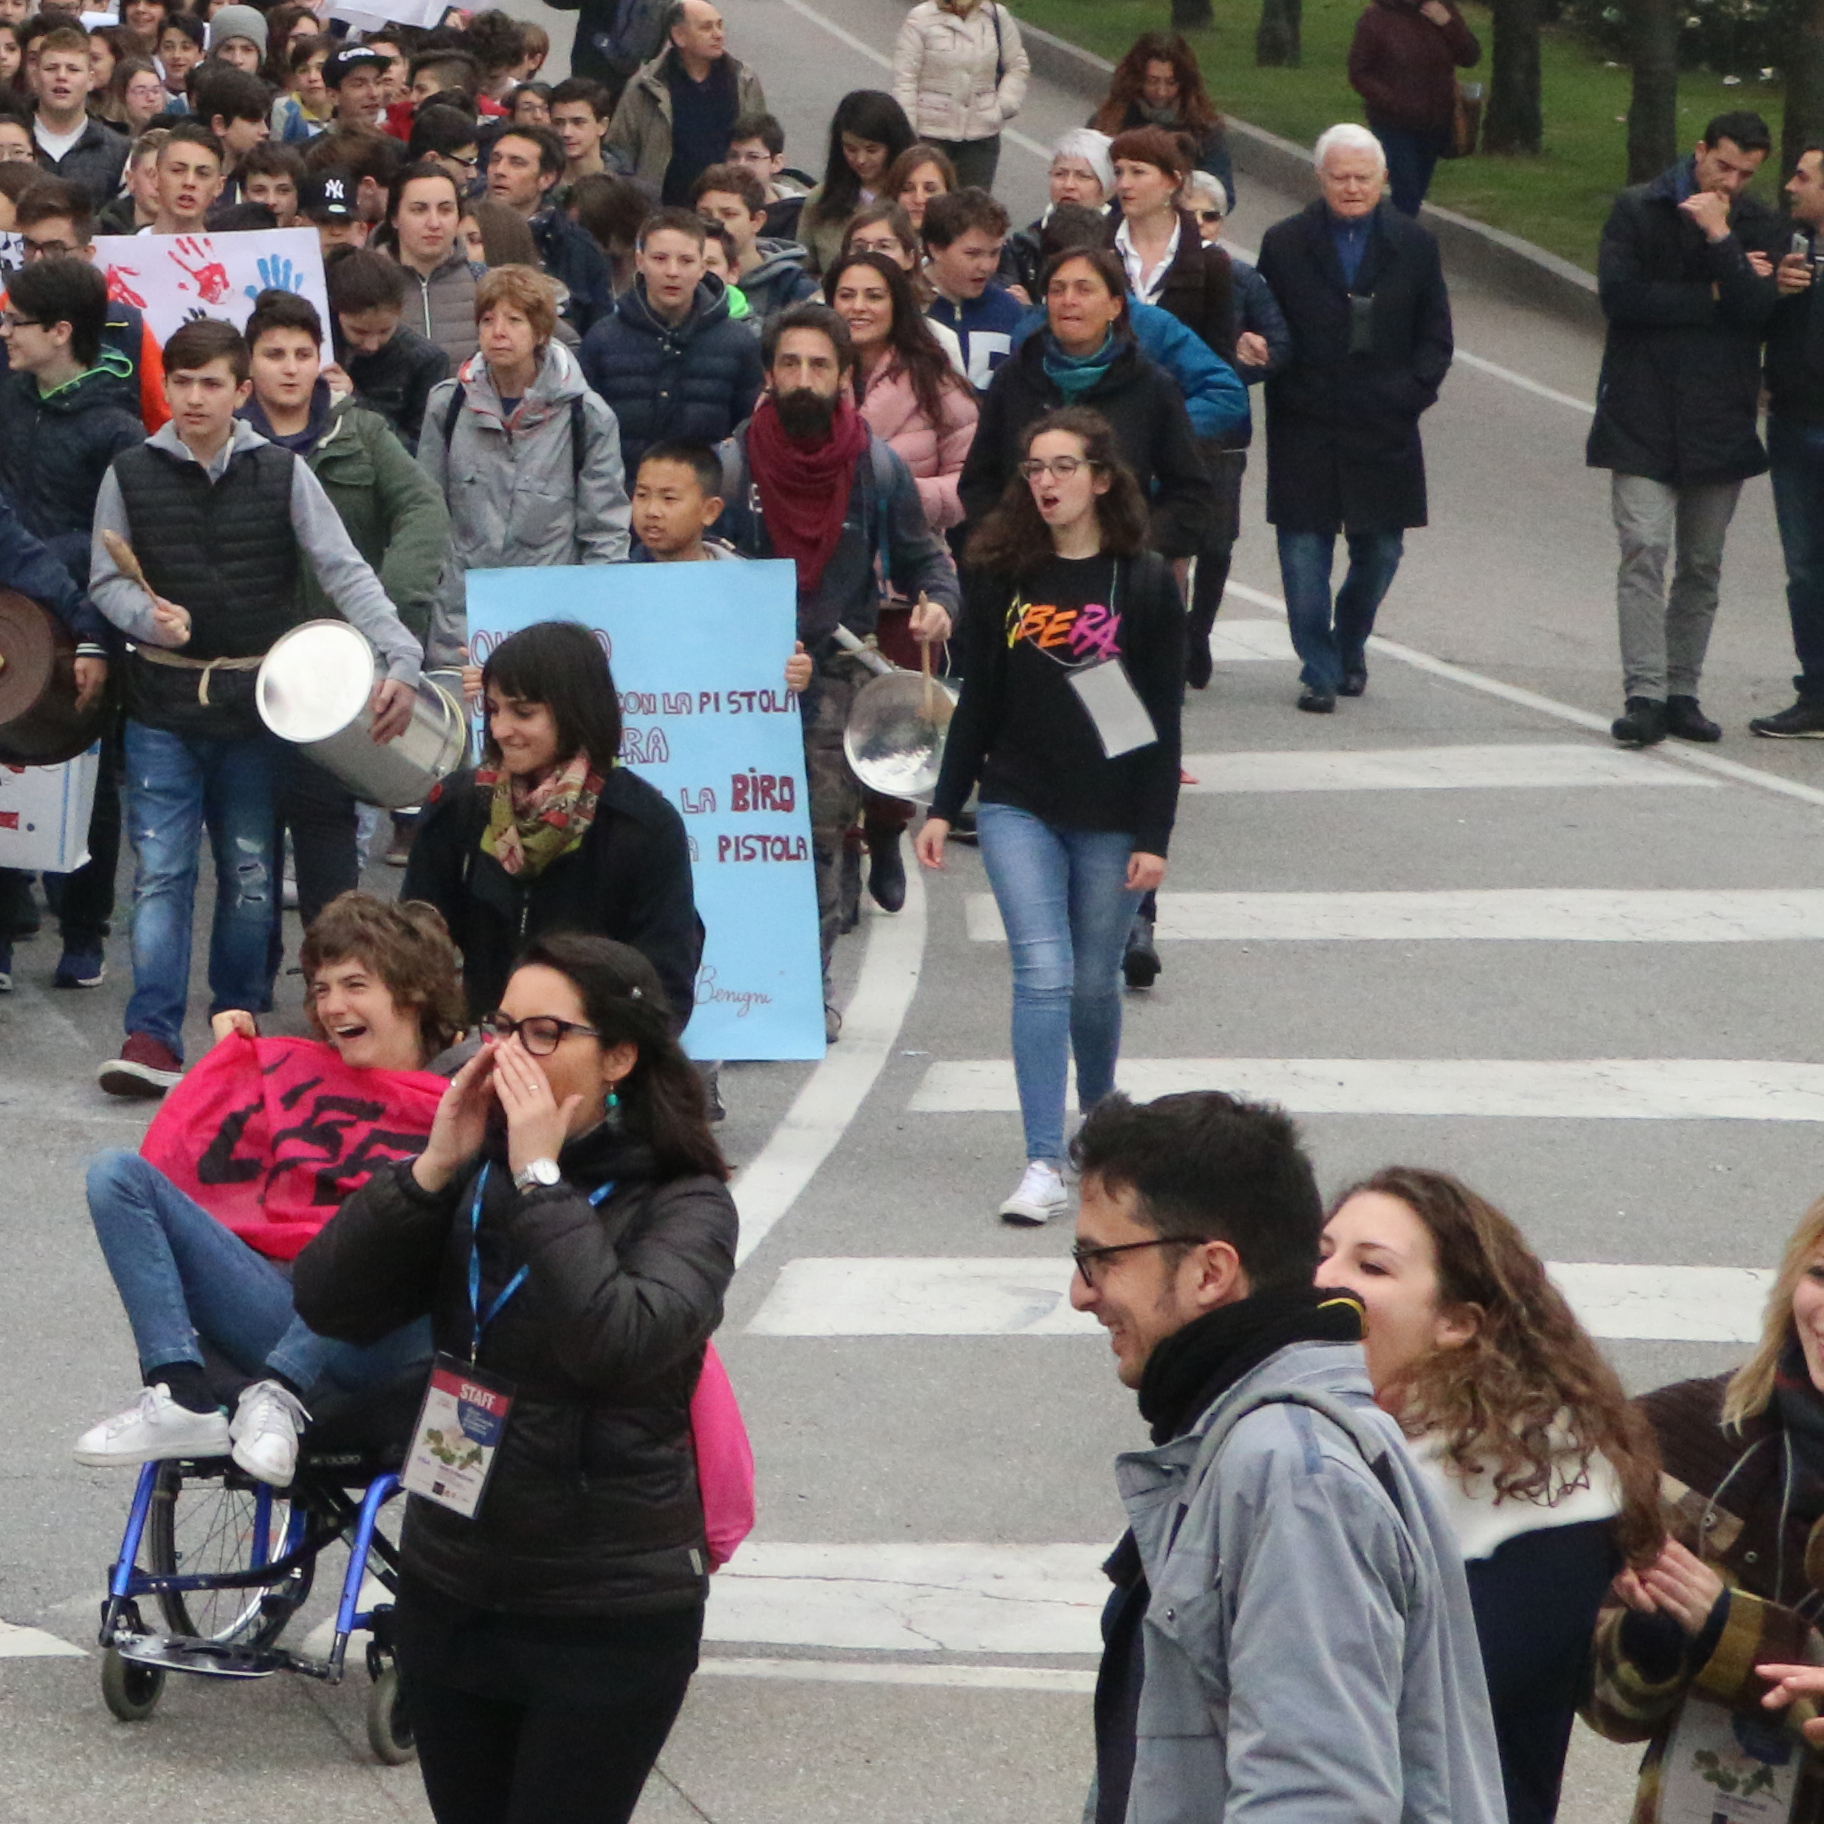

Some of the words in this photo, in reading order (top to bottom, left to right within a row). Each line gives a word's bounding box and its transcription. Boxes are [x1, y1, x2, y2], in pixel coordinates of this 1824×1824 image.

[663, 691, 693, 715] LA
[680, 786, 717, 814] LA
[718, 834, 809, 864] PISTOLA
[459, 1383, 497, 1410] STAFF
